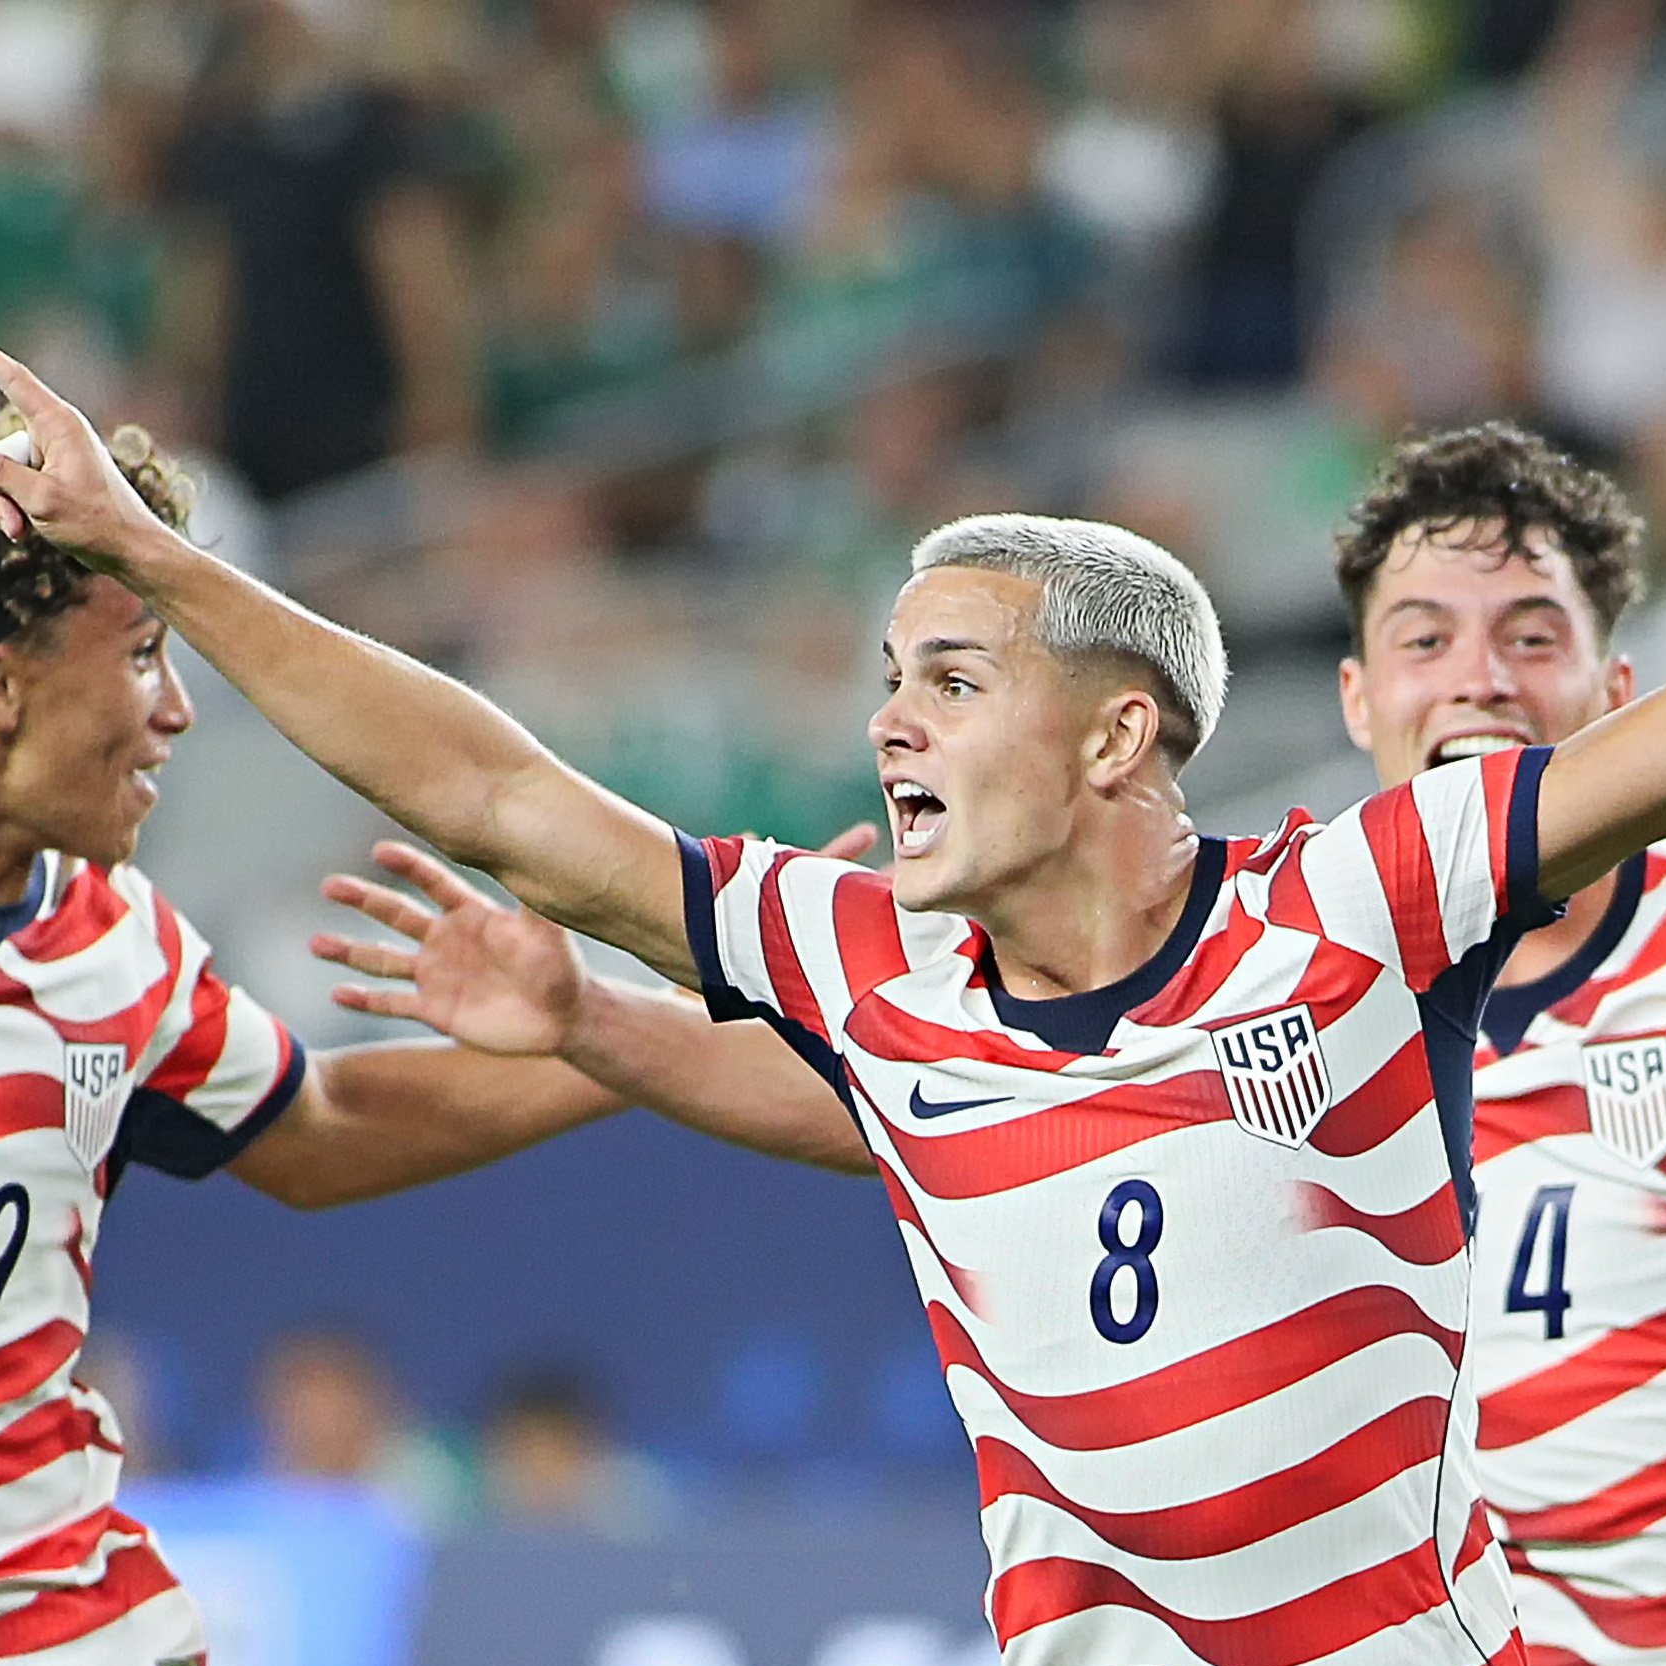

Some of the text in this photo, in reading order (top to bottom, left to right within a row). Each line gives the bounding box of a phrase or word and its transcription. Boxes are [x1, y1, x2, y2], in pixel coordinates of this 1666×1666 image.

[1221, 1014, 1309, 1072] USA
[1590, 1046, 1664, 1095] USA
[71, 1052, 119, 1098] USA
[1089, 1179, 1165, 1343] 8
[1472, 1184, 1576, 1340] 4
